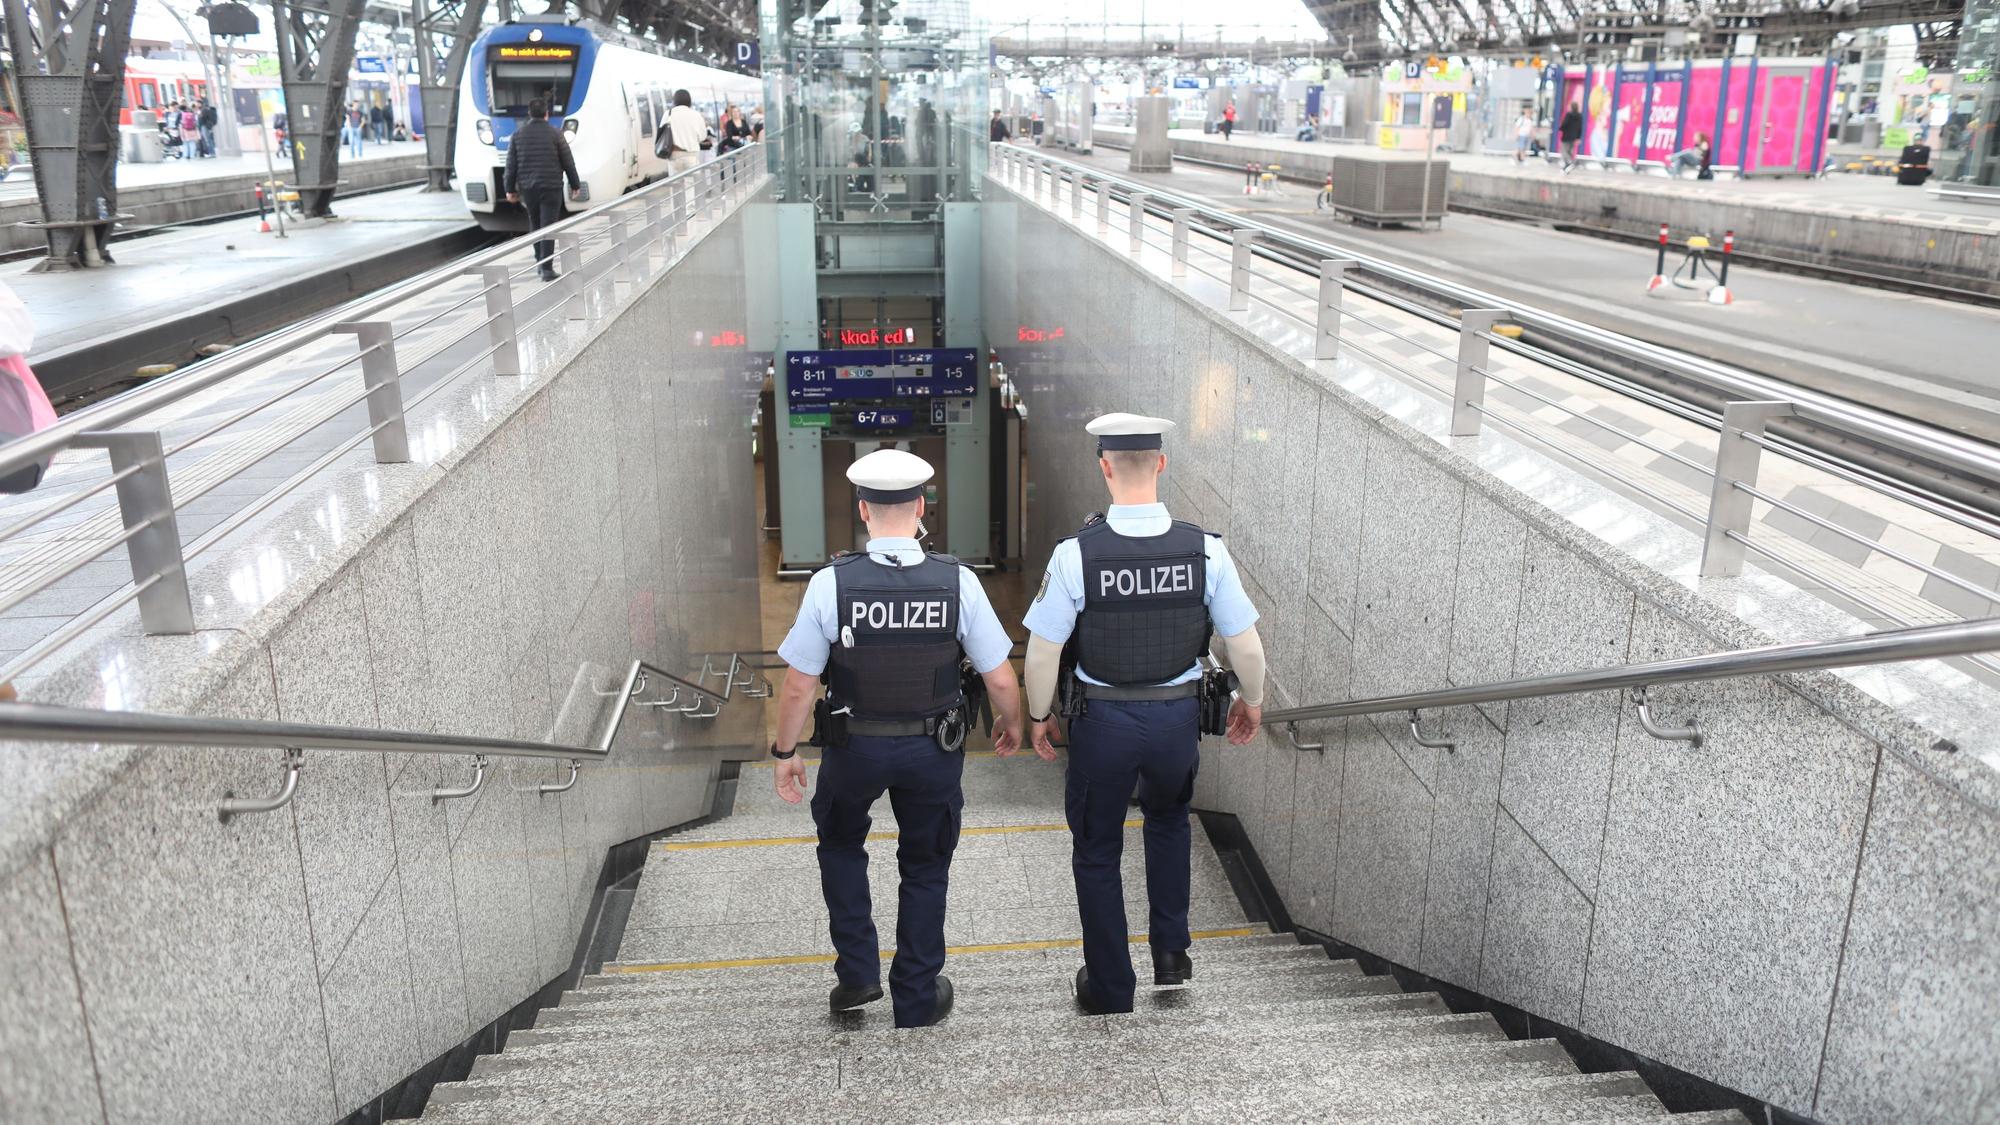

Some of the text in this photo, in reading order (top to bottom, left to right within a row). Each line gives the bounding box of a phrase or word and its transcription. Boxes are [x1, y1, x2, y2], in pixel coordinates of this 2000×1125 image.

[519, 48, 535, 56] nicht
[737, 43, 751, 62] D
[803, 370, 825, 381] 8-11
[945, 367, 963, 378] 1-5
[858, 411, 878, 423] 6-7
[1099, 564, 1194, 597] POLIZEI
[851, 600, 948, 629] POLIZEI
